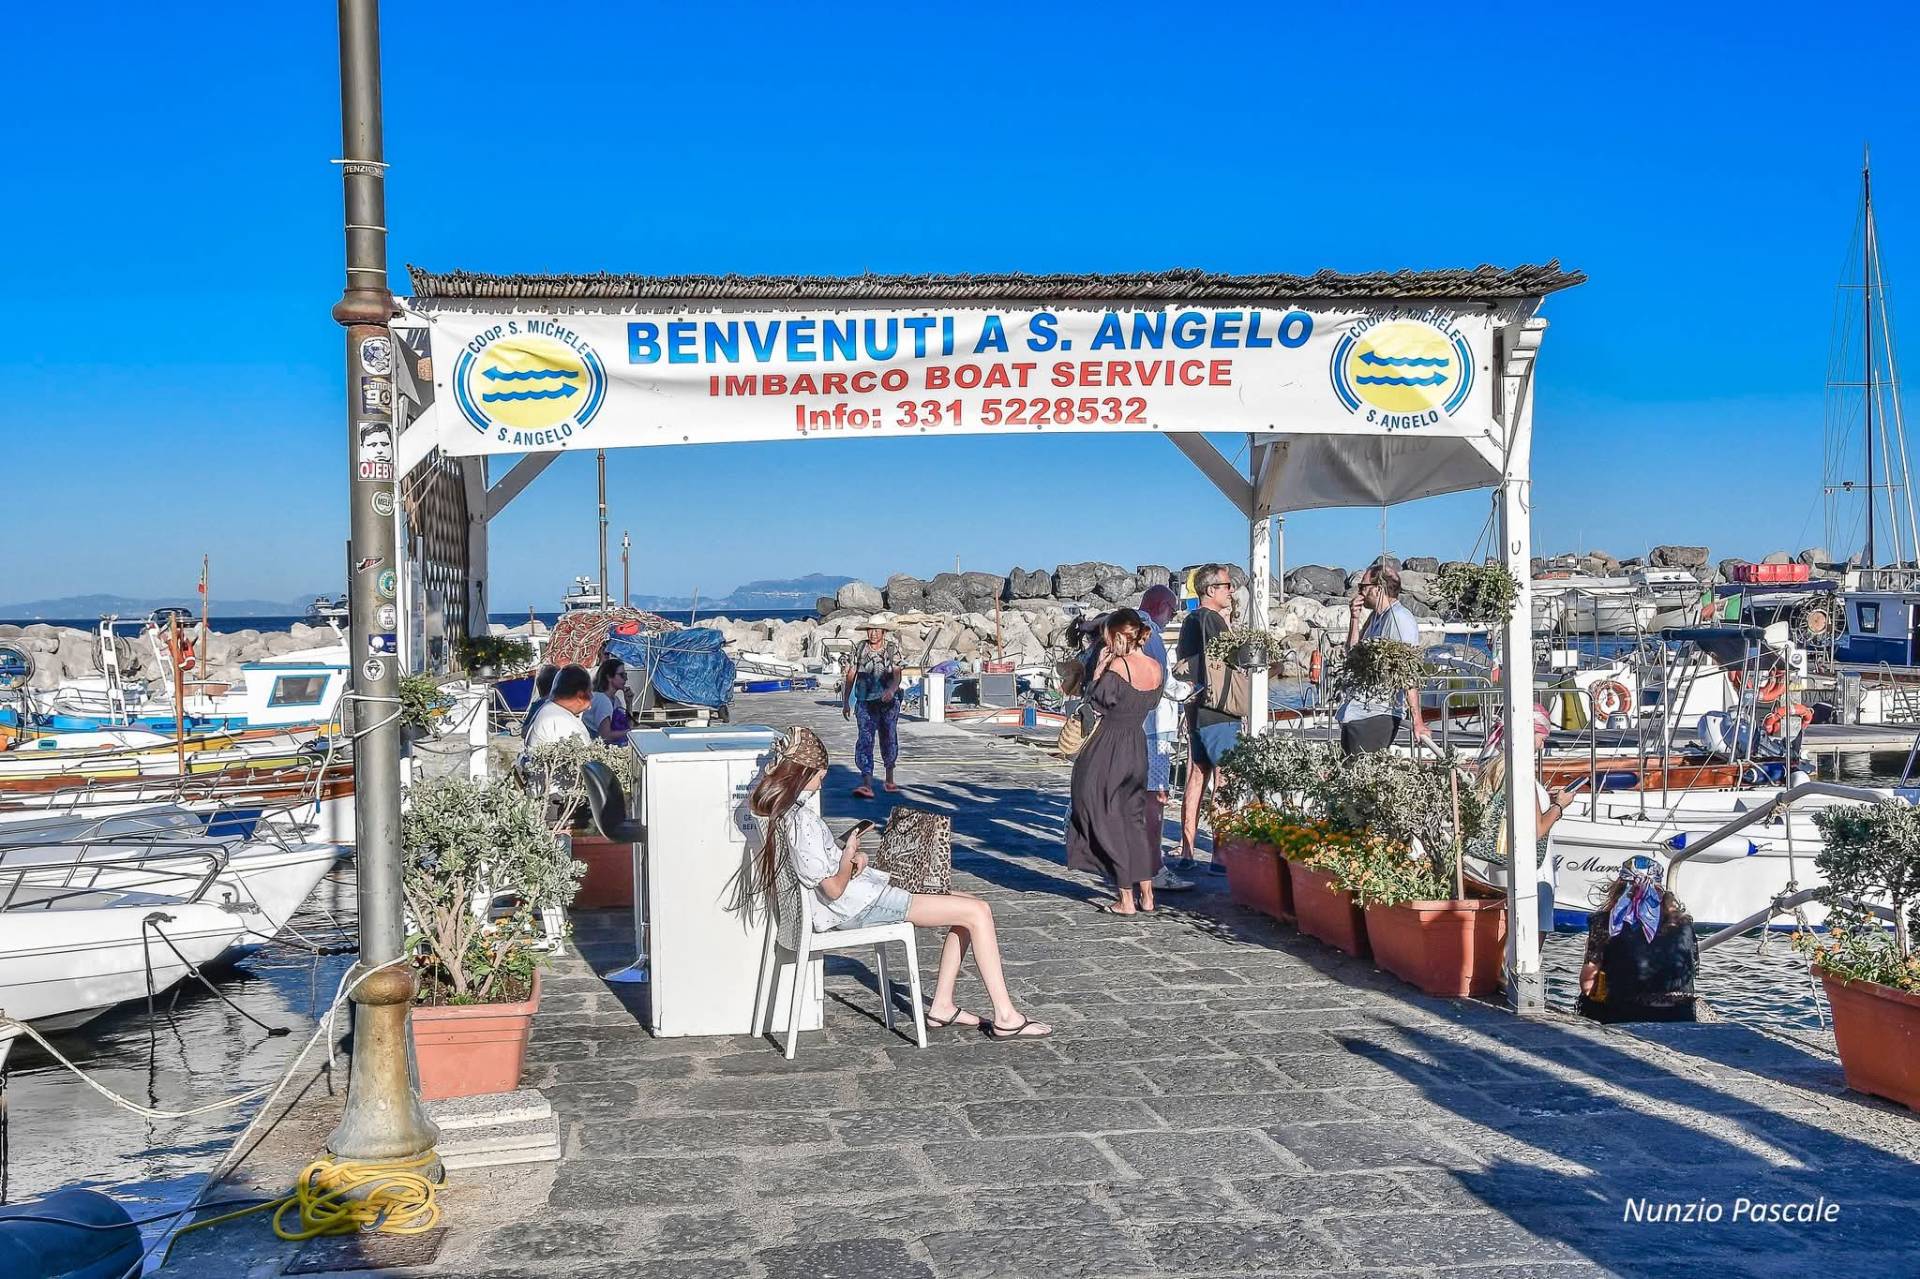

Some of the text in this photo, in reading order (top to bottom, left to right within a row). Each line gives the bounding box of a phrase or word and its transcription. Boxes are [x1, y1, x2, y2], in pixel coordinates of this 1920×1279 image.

[508, 321, 522, 335] S.
[528, 320, 589, 355] MICHELE
[627, 310, 1314, 364] BENVENUTI A S. ANGELO
[1406, 308, 1461, 341] MICHELE
[709, 359, 1233, 397] IMBARCO BOAT SERVICE
[796, 396, 1148, 431] Info: 331 5228532
